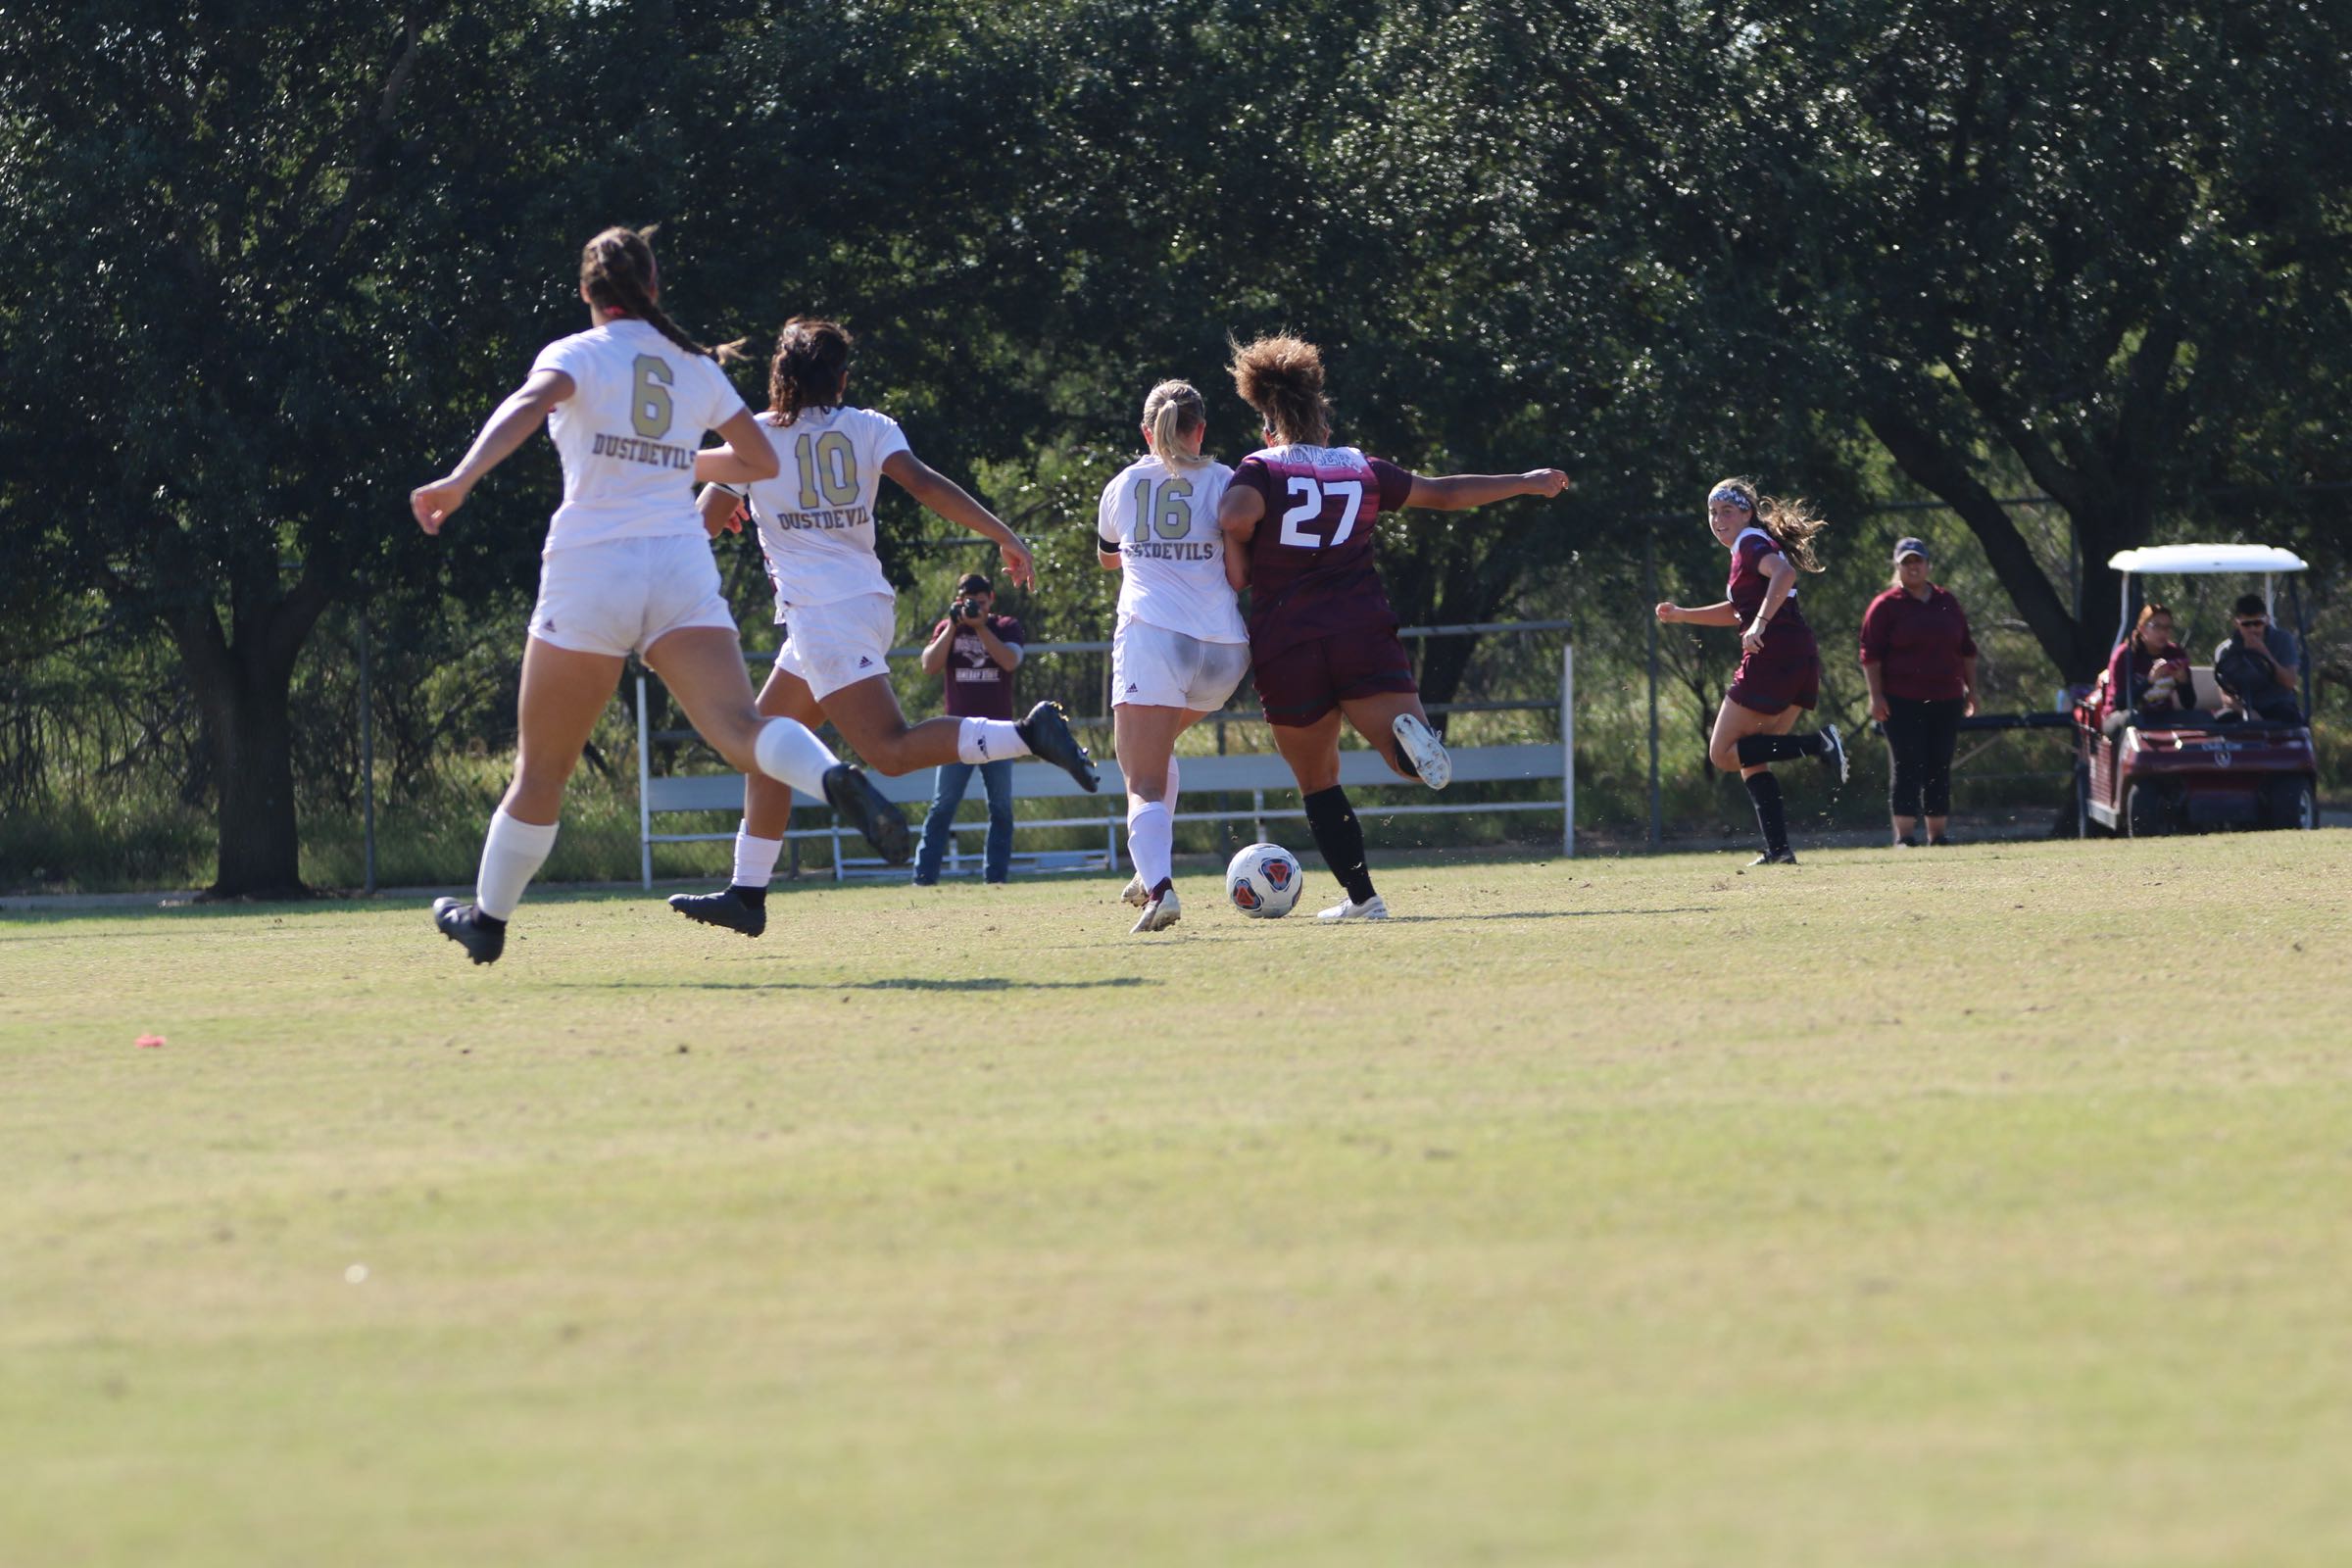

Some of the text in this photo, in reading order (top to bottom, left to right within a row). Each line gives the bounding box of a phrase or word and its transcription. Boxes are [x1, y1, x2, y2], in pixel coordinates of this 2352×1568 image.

[633, 354, 673, 439] 6
[796, 431, 859, 509] 10
[1133, 477, 1194, 543] 16
[1280, 476, 1362, 548] 27
[1126, 543, 1213, 561] STDEVILS
